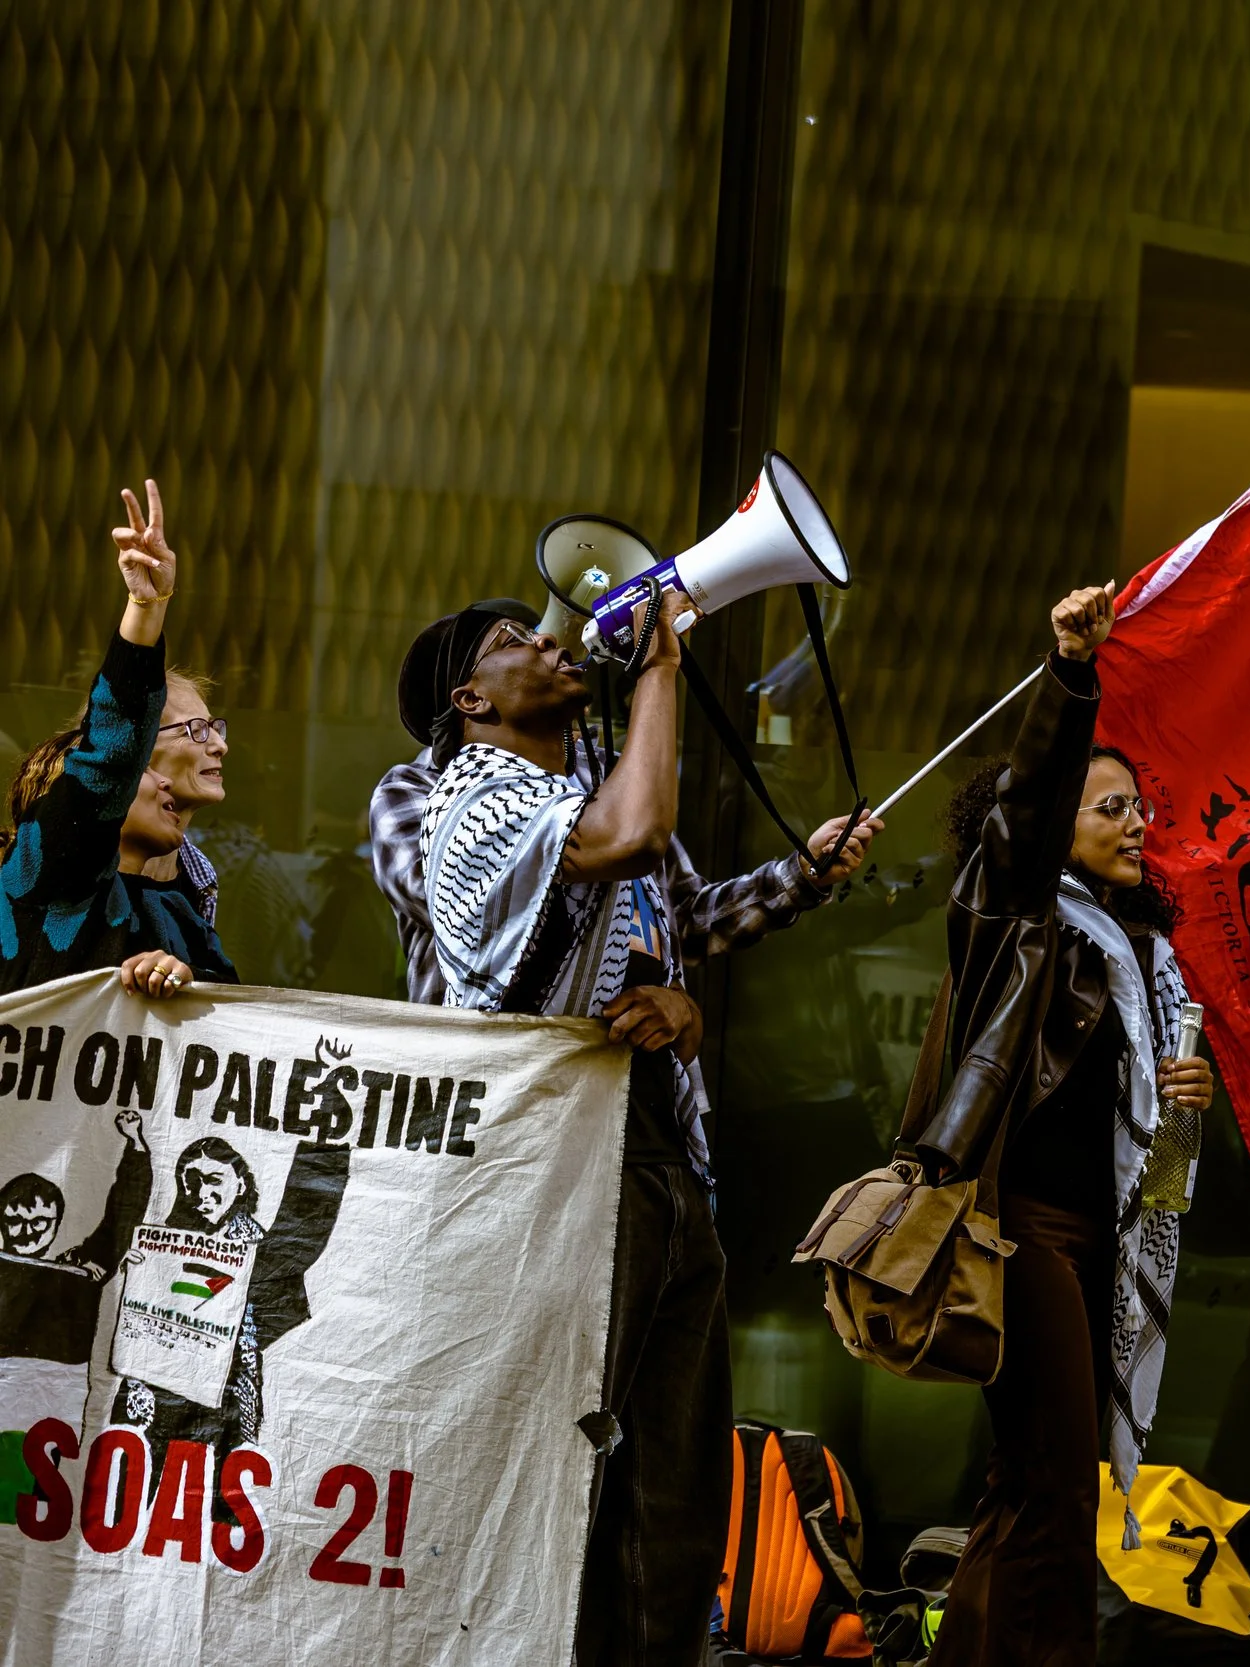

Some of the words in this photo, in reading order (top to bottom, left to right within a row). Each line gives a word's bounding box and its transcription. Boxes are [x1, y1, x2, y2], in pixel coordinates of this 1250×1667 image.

[1137, 761, 1176, 830] HASTA
[1178, 838, 1201, 859] LA
[1206, 861, 1250, 984] VICTORIA
[74, 1031, 163, 1111] ON
[174, 1043, 487, 1158] PALESTINE
[137, 1228, 181, 1244] FIGHT
[184, 1235, 249, 1257] RACISM!
[138, 1240, 168, 1253] FIGHT
[169, 1244, 244, 1268] IMPERIALISM!
[123, 1296, 148, 1312] LONG
[151, 1304, 174, 1320] LIVE
[175, 1312, 237, 1342] PALESTINE!
[16, 1417, 272, 1574] SOAS
[309, 1464, 414, 1589] 2!
